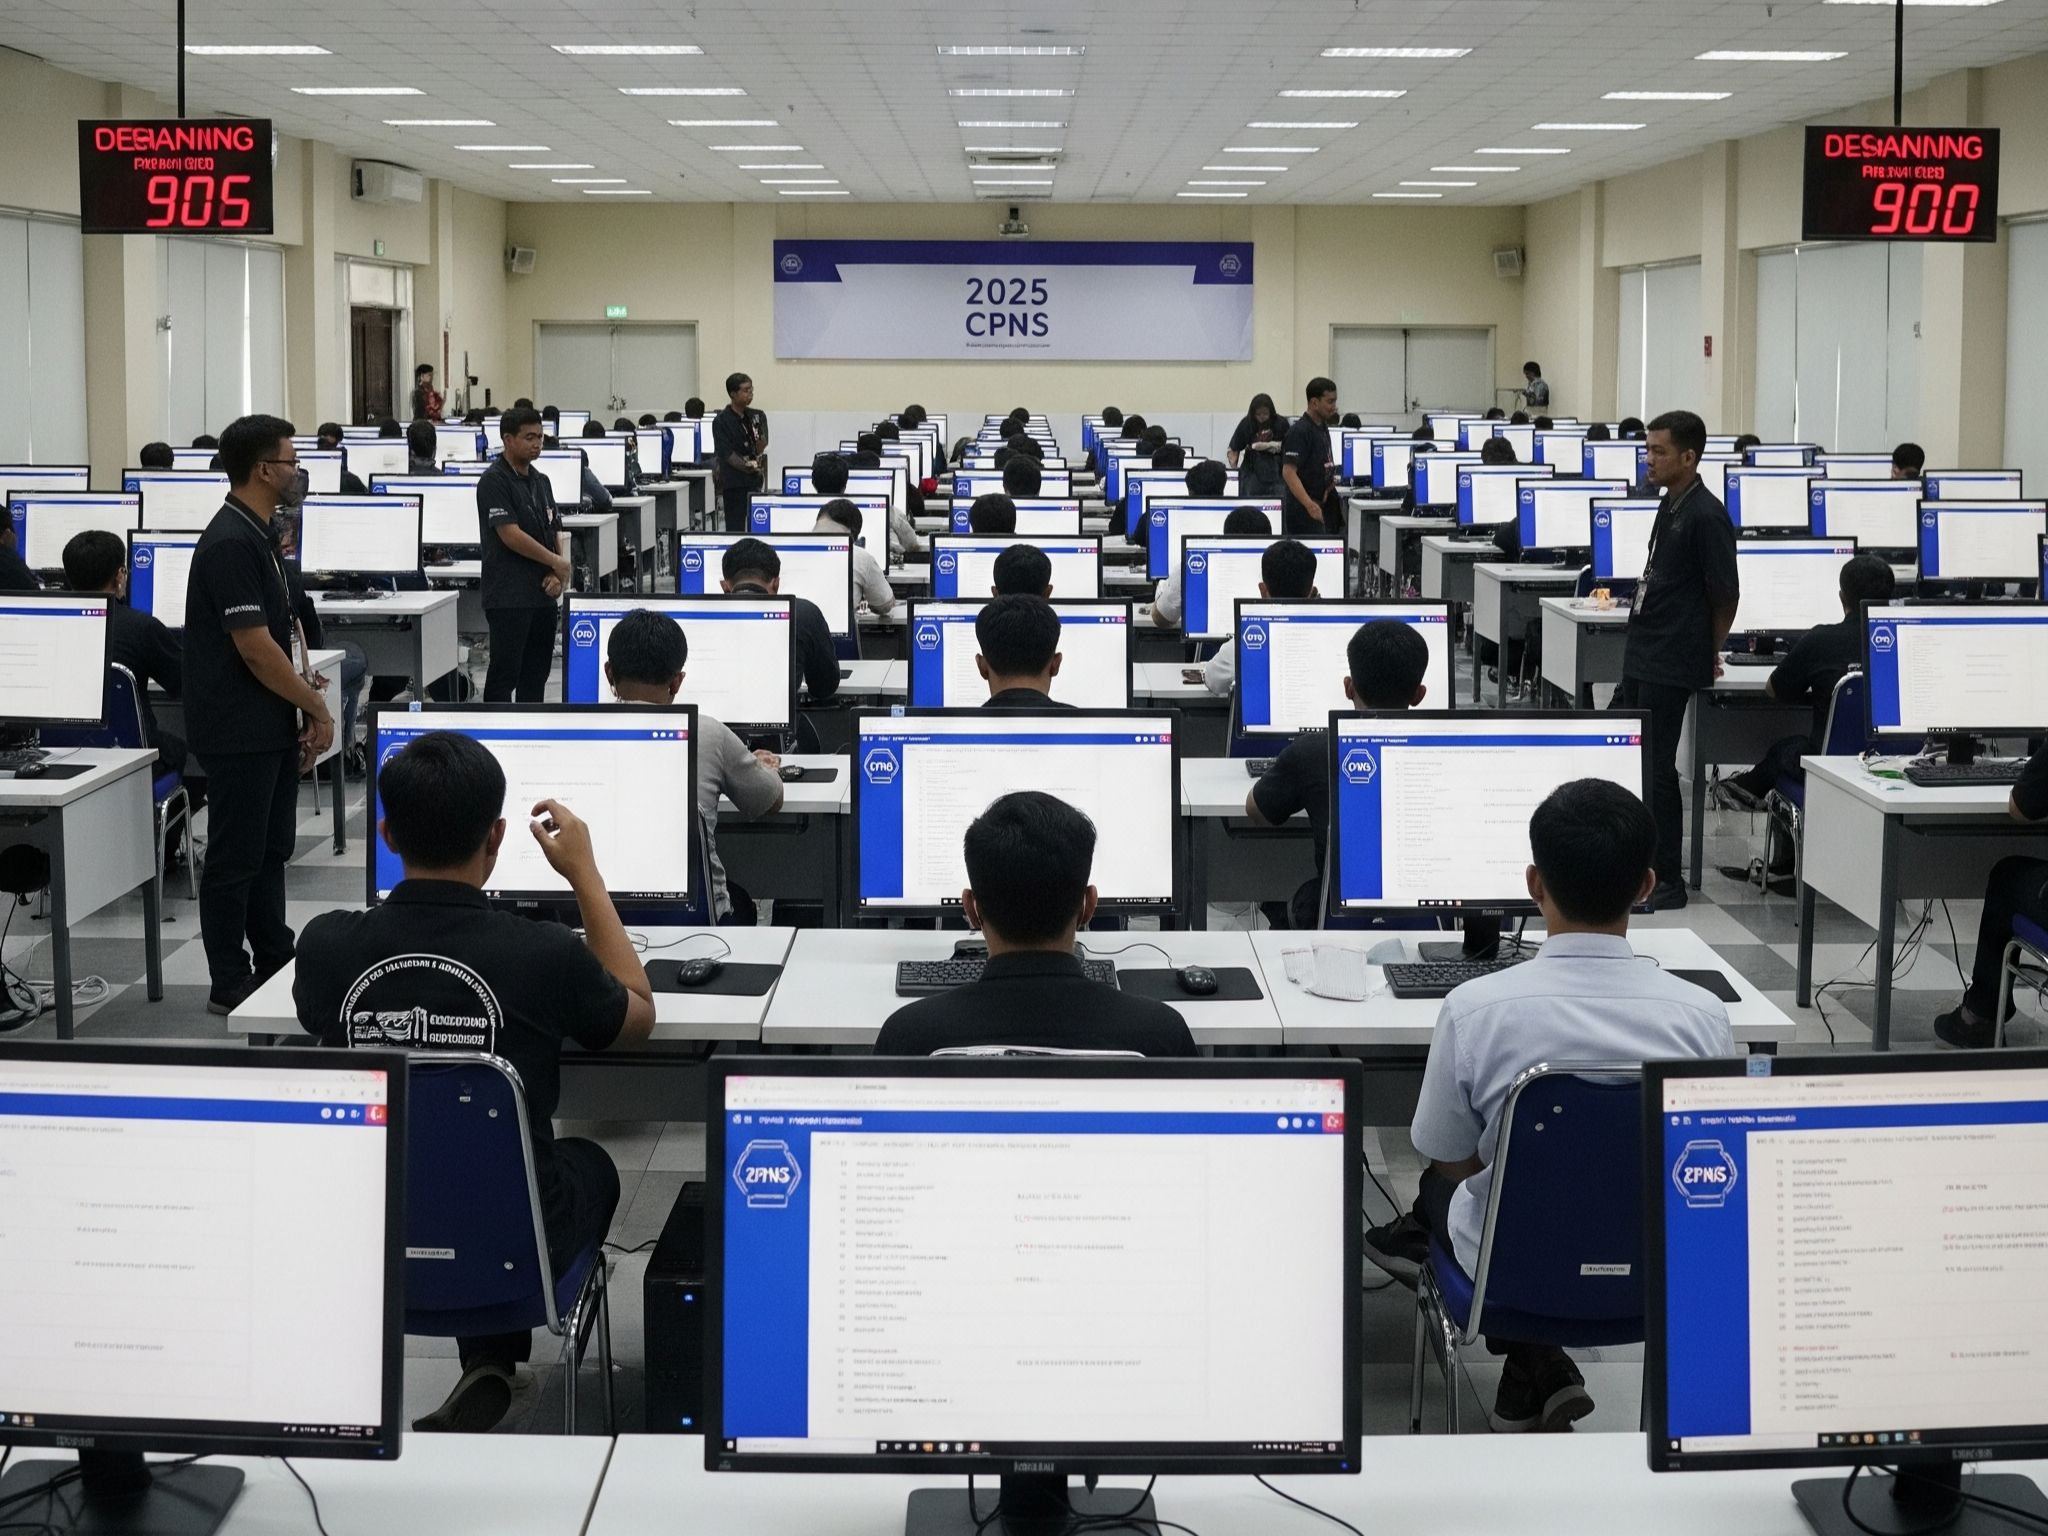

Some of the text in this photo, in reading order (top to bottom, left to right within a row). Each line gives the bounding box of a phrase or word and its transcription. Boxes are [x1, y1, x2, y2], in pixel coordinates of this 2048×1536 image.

[146, 175, 251, 227] 905
[1871, 183, 1980, 235] 900
[966, 278, 1048, 305] 2025
[965, 311, 1048, 337] CPNS
